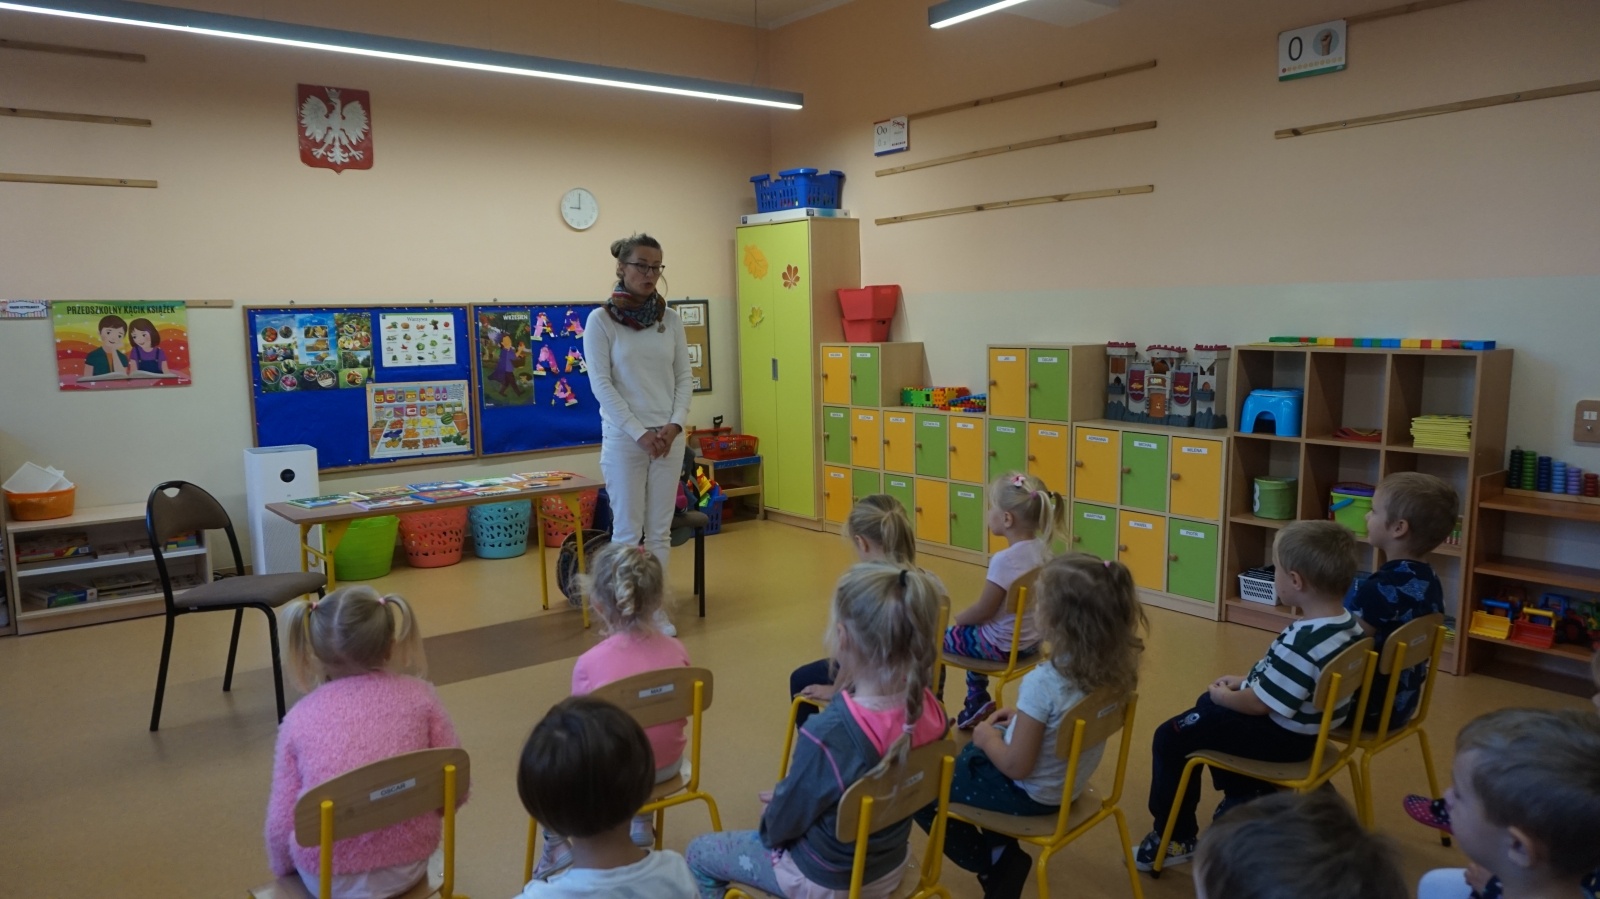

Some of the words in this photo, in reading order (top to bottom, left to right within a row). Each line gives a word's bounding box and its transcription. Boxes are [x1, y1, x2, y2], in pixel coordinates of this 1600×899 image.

[66, 305, 121, 315] PRZEDSZKOLNY
[123, 305, 145, 317] KĄCIK
[146, 304, 175, 317] KSIĄŻEK
[380, 783, 406, 796] OSCAR
